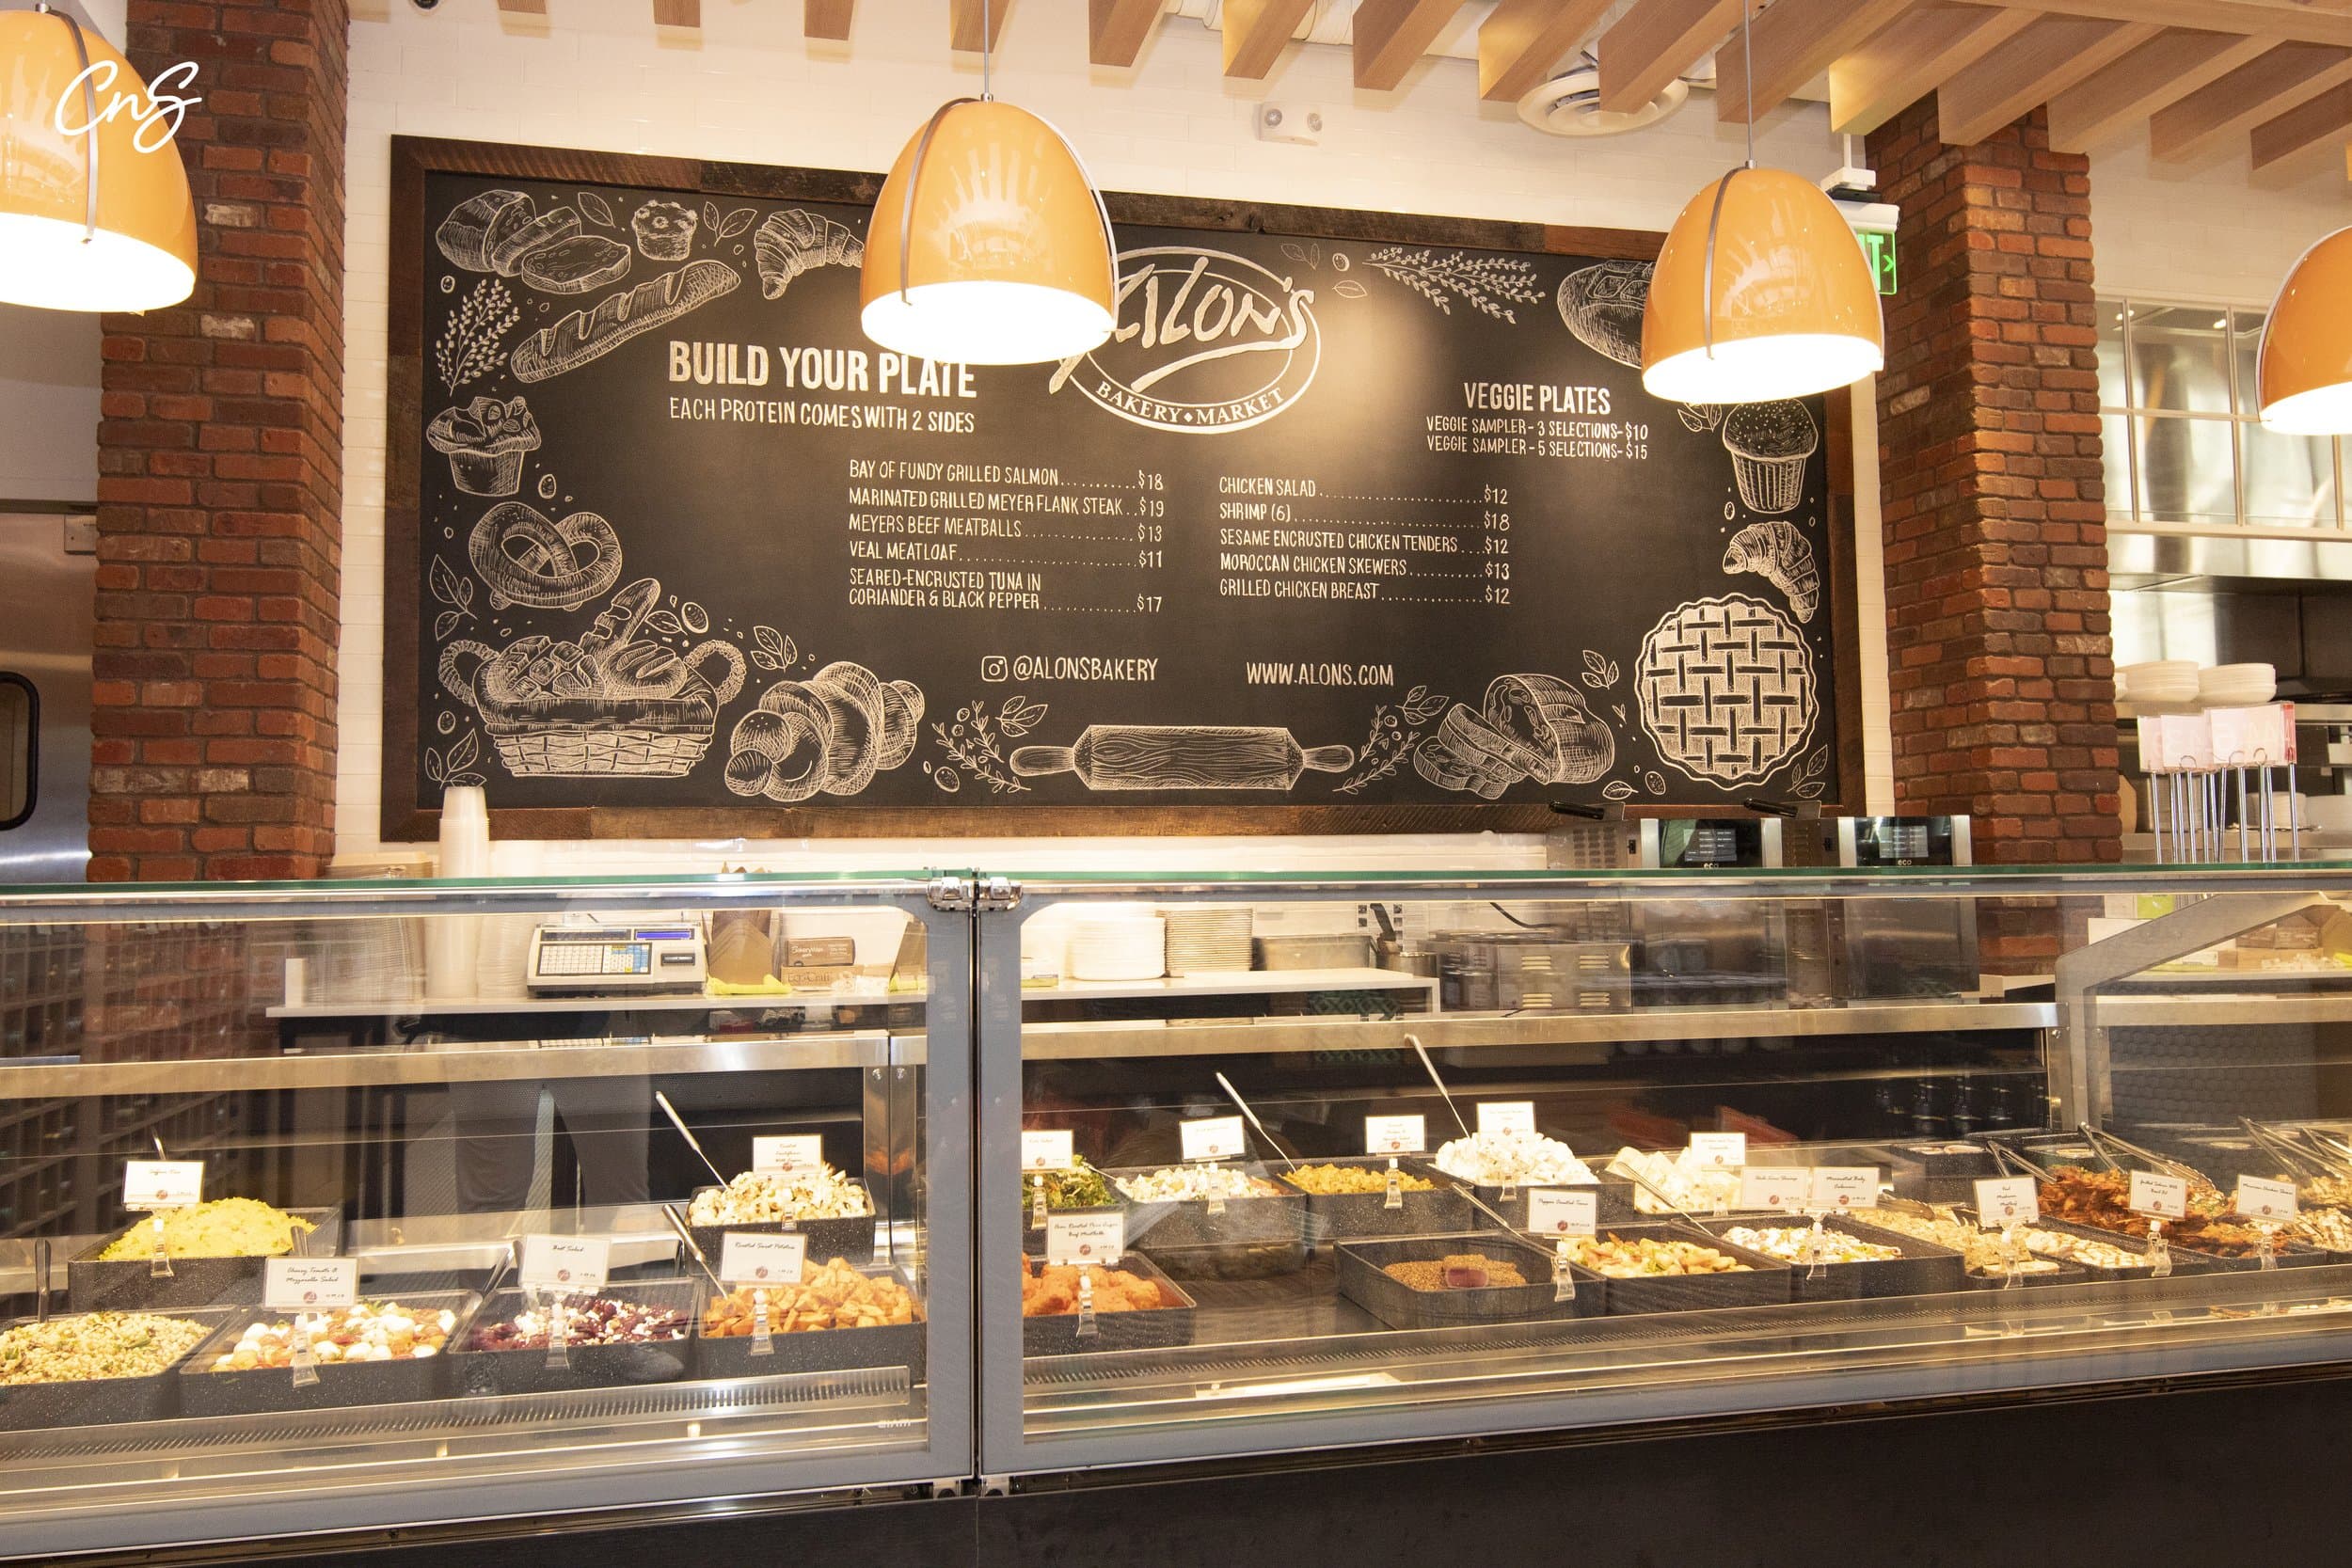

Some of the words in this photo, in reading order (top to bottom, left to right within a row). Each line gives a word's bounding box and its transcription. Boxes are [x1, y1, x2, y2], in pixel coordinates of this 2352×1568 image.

[669, 341, 769, 387] BUILD
[779, 347, 868, 392] YOUR
[879, 353, 977, 398] PLATE
[1096, 380, 1183, 423] BAKERY
[1197, 388, 1284, 425] MARKET
[1463, 382, 1534, 412] VEGGIE
[1539, 386, 1611, 415] PLATES
[669, 396, 715, 420] EACH
[721, 399, 795, 423] PROTEIN
[801, 403, 861, 429] COMES
[864, 405, 907, 430] WITH
[912, 410, 923, 431] 2
[928, 411, 975, 433] SIDES
[1426, 415, 1468, 433] VEGGIE
[1537, 420, 1546, 436] 3
[1626, 421, 1648, 441] $10
[1427, 435, 1468, 452] VEGGIE
[1538, 441, 1546, 456] 5
[1626, 440, 1647, 460] $15
[850, 459, 876, 479] BAY
[880, 461, 896, 479] OF
[899, 462, 944, 481] FUNDY
[947, 464, 1001, 483] GRILLED
[1004, 467, 1058, 486] SALMON
[1138, 469, 1164, 490] $18
[849, 487, 928, 508] MARINATED
[930, 491, 985, 510] GRILLED
[988, 494, 1034, 513] MEYER
[1037, 495, 1079, 515] FLANK
[1083, 497, 1123, 515] STEAK
[1139, 496, 1164, 517] $19
[1219, 476, 1274, 495] CHICKEN
[1277, 479, 1316, 497] SALAD
[1484, 483, 1508, 505] $12
[849, 514, 904, 533] MEYERS
[908, 515, 941, 534] BEEF
[945, 517, 1022, 537] MEATBALLS
[1137, 523, 1162, 543] $13
[1219, 502, 1267, 520] SHRIMP
[1271, 503, 1291, 523] (6)
[1484, 510, 1510, 531] $18
[850, 541, 882, 560] VEAL
[886, 542, 958, 561] MEATLOAF
[1138, 549, 1163, 568] $11
[1220, 529, 1270, 546] SESAME
[1274, 530, 1344, 548] ENCRUSTED
[1348, 533, 1399, 551] CHICKEN
[1402, 535, 1458, 553] TENDERS
[1485, 535, 1509, 555] $12
[850, 567, 984, 589] SEARED-ENCRUSTED
[989, 571, 1024, 591] TUNA
[1027, 573, 1041, 592] IN
[1220, 552, 1290, 572] MOROCCAN
[1293, 555, 1345, 574] CHICKEN
[1348, 557, 1406, 577] SKEWERS
[1485, 561, 1510, 580] $13
[849, 588, 926, 607] CORIANDER
[929, 590, 939, 607] &
[943, 590, 985, 609] BLACK
[989, 592, 1040, 610] PEPPER
[1136, 594, 1163, 612] $17
[1219, 578, 1271, 596] GRILLED
[1275, 580, 1327, 599] CHICKEN
[1331, 581, 1380, 600] BREAST
[1485, 585, 1511, 605] $12
[1013, 655, 1158, 682] @ALONSBAKERY
[1246, 661, 1394, 687] WWW.ALONS.COM
